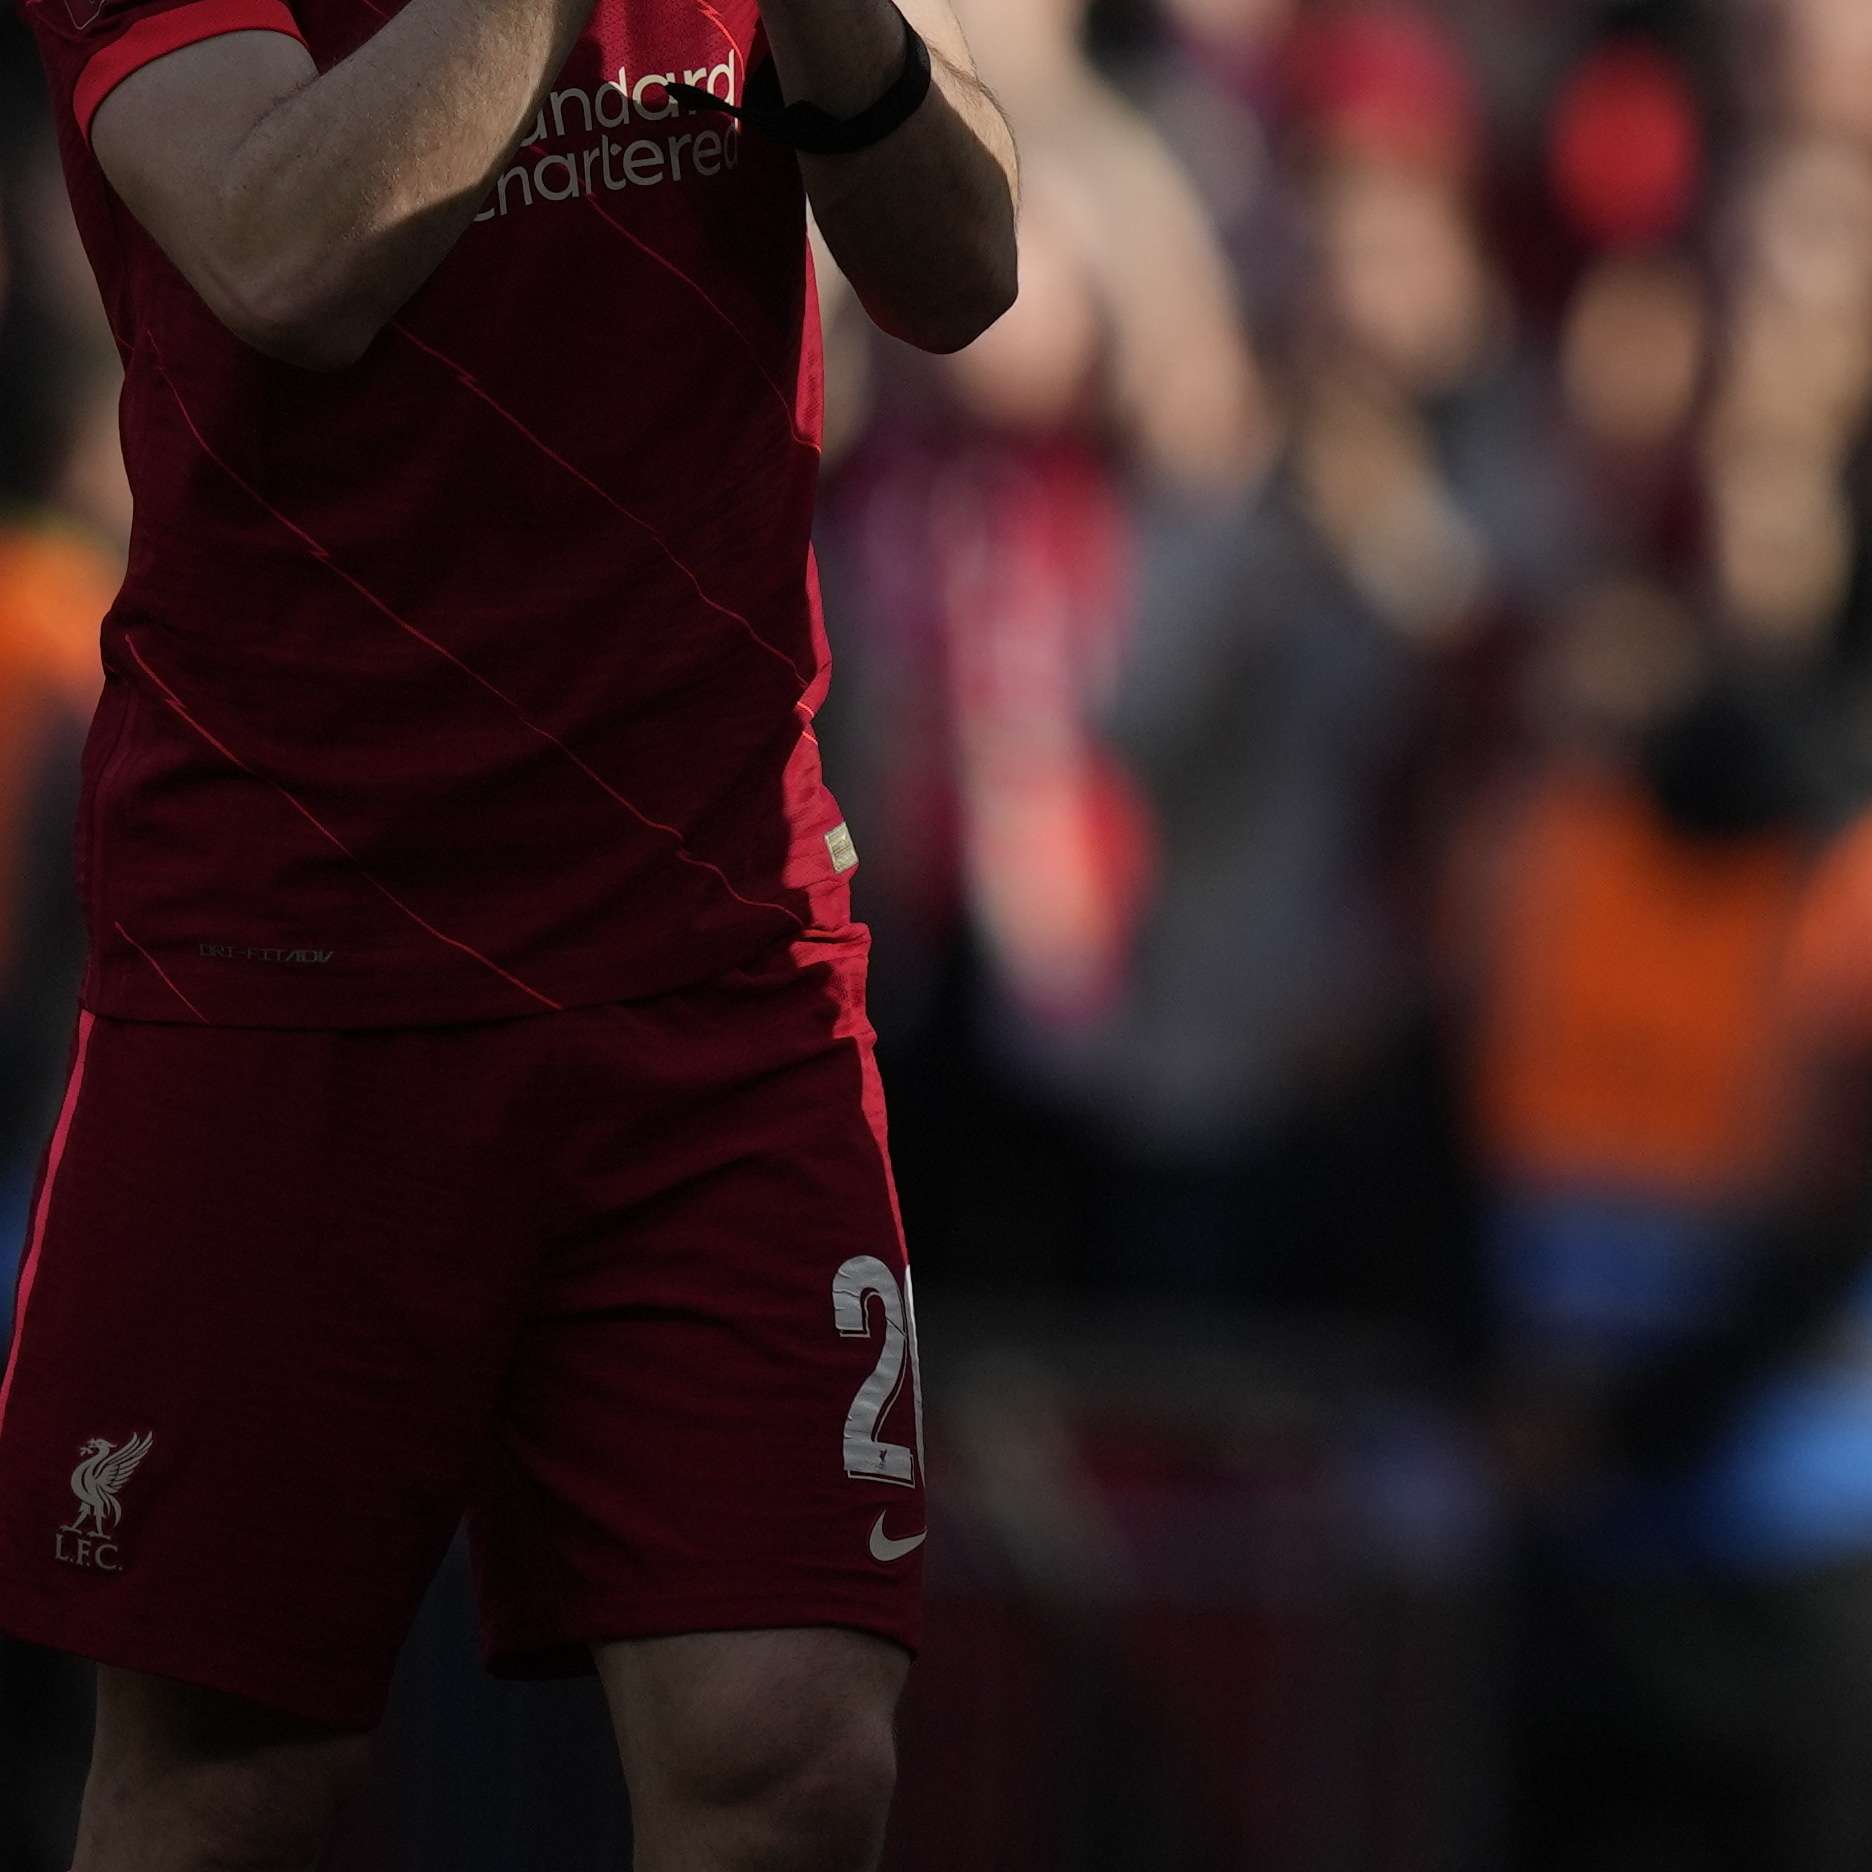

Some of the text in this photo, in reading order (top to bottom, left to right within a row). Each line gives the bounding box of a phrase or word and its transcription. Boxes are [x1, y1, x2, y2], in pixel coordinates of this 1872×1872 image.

[473, 118, 741, 223] hartered
[832, 1254, 925, 1489] 2
[56, 1533, 123, 1572] L.F.C.
